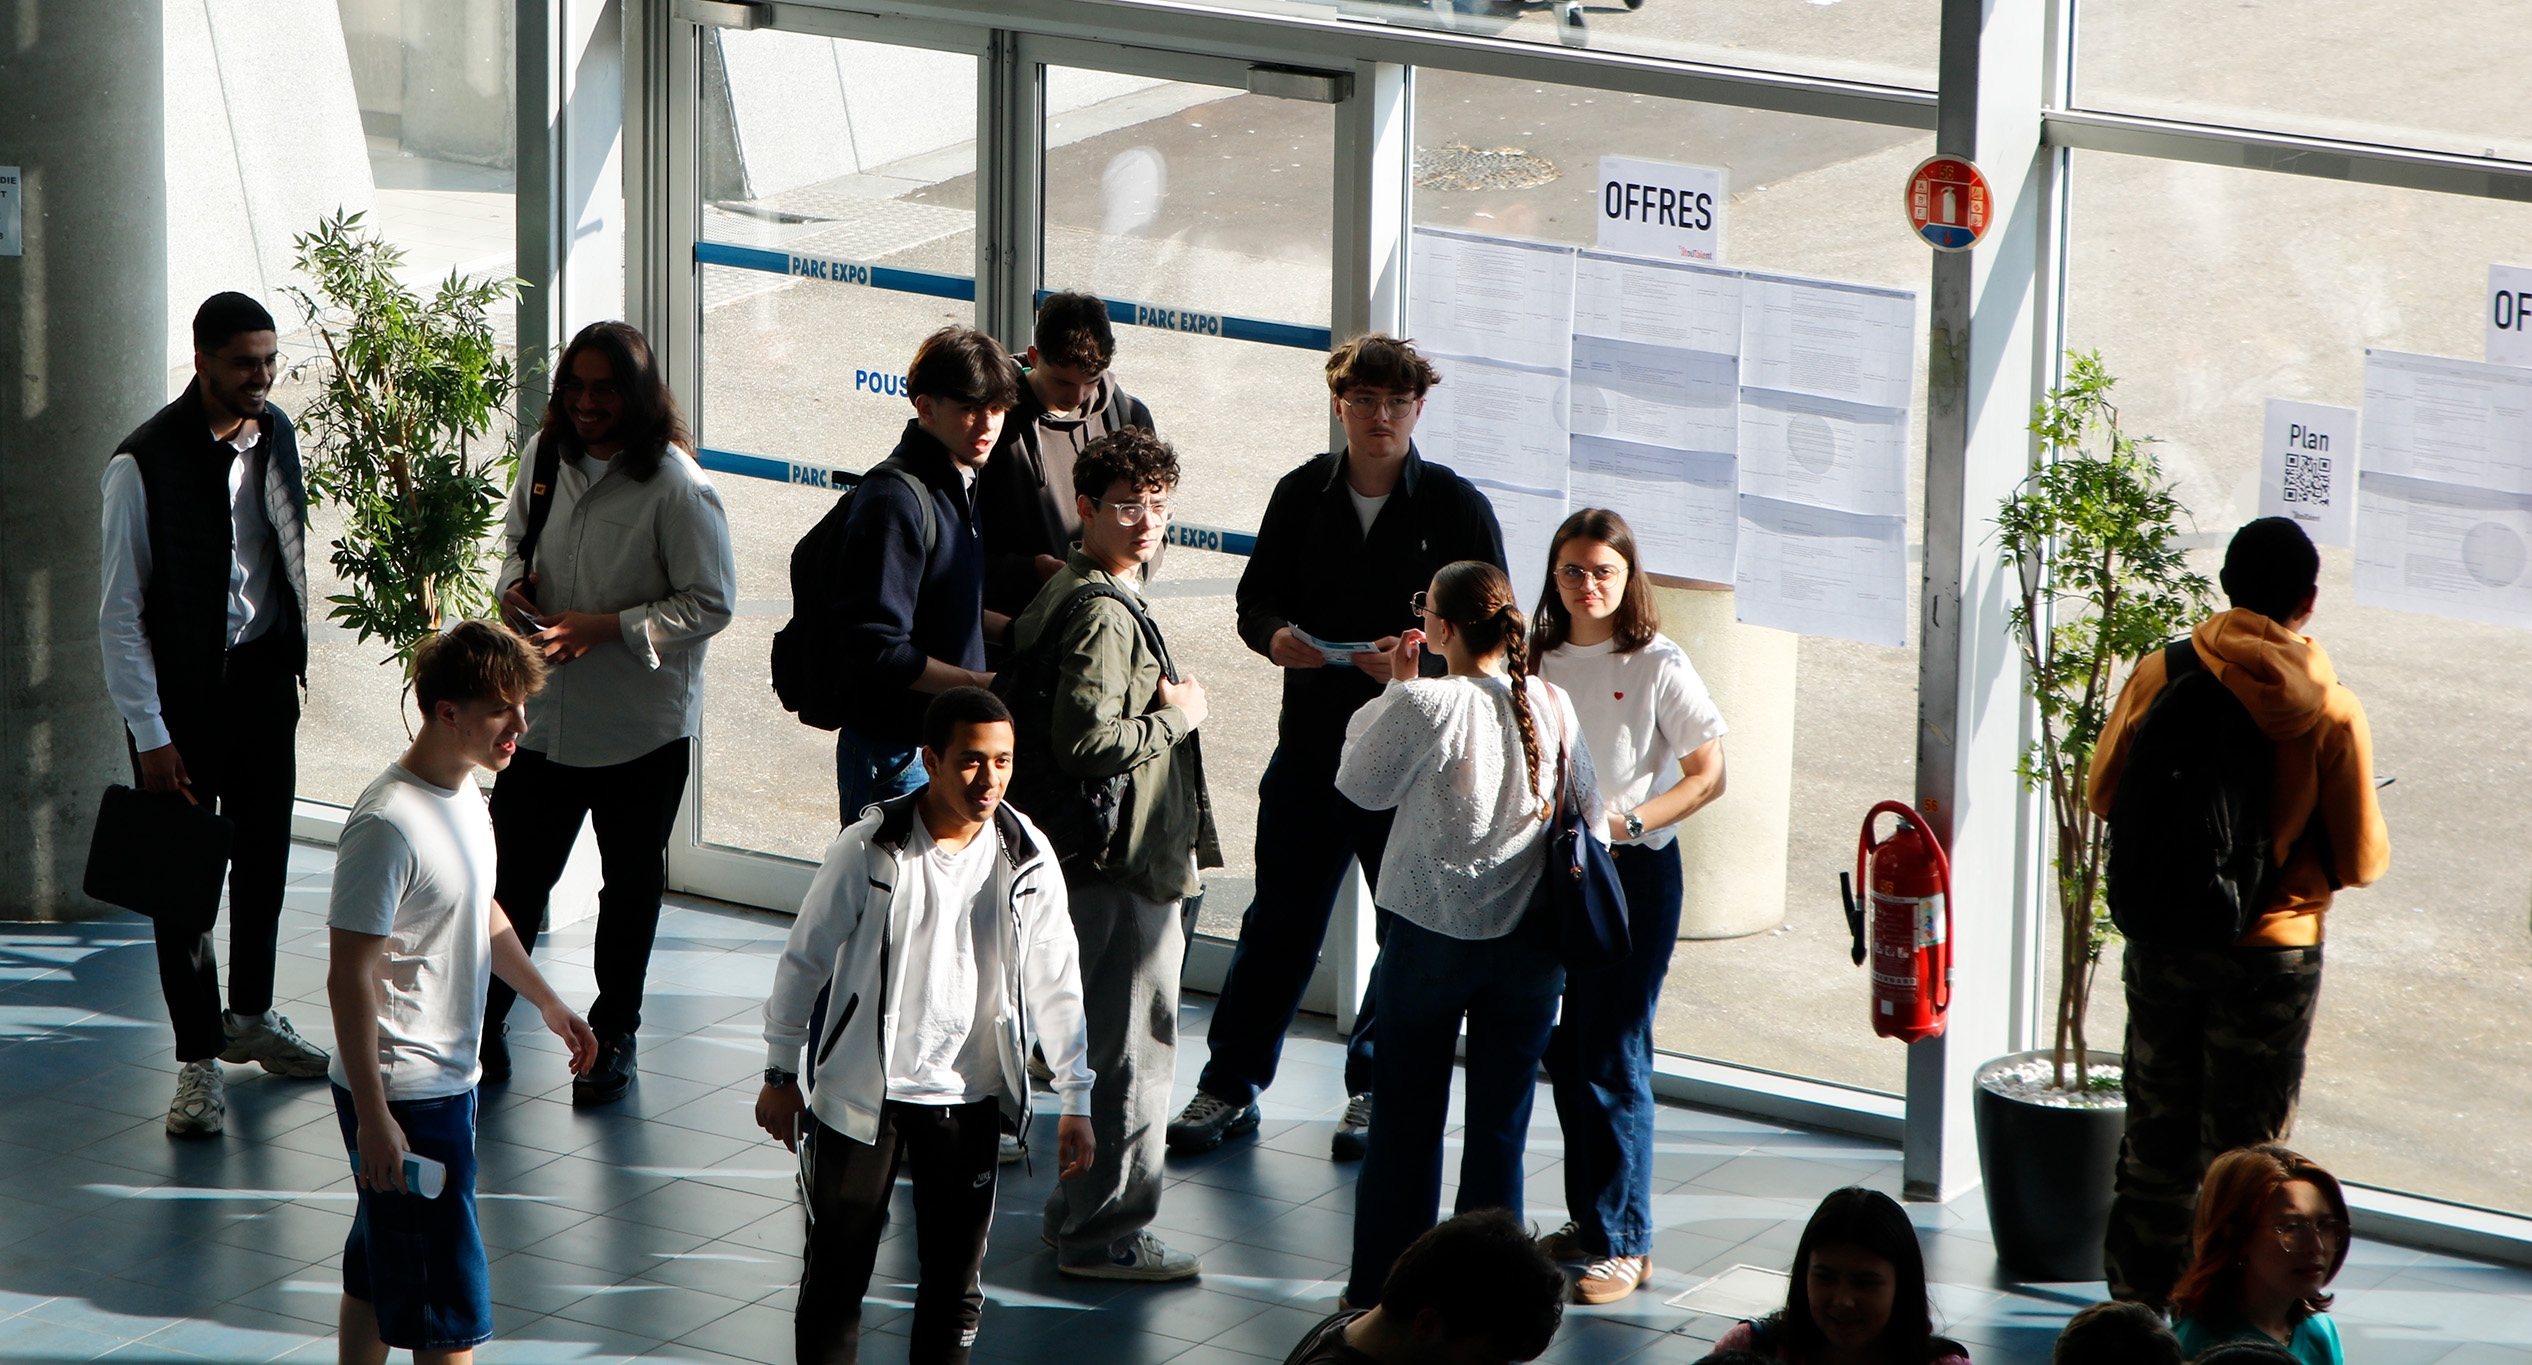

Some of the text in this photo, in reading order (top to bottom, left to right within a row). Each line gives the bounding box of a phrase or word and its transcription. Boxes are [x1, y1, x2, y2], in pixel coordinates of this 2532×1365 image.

[1940, 165, 1954, 180] 56
[1605, 180, 1712, 232] OFFRES
[793, 256, 867, 285] PARC EXPO
[1139, 306, 1218, 335] PARC EXPO
[2290, 423, 2329, 451] Plan
[793, 465, 827, 488] PARC
[1181, 527, 1218, 551] EXPO
[1923, 798, 1938, 813] 56
